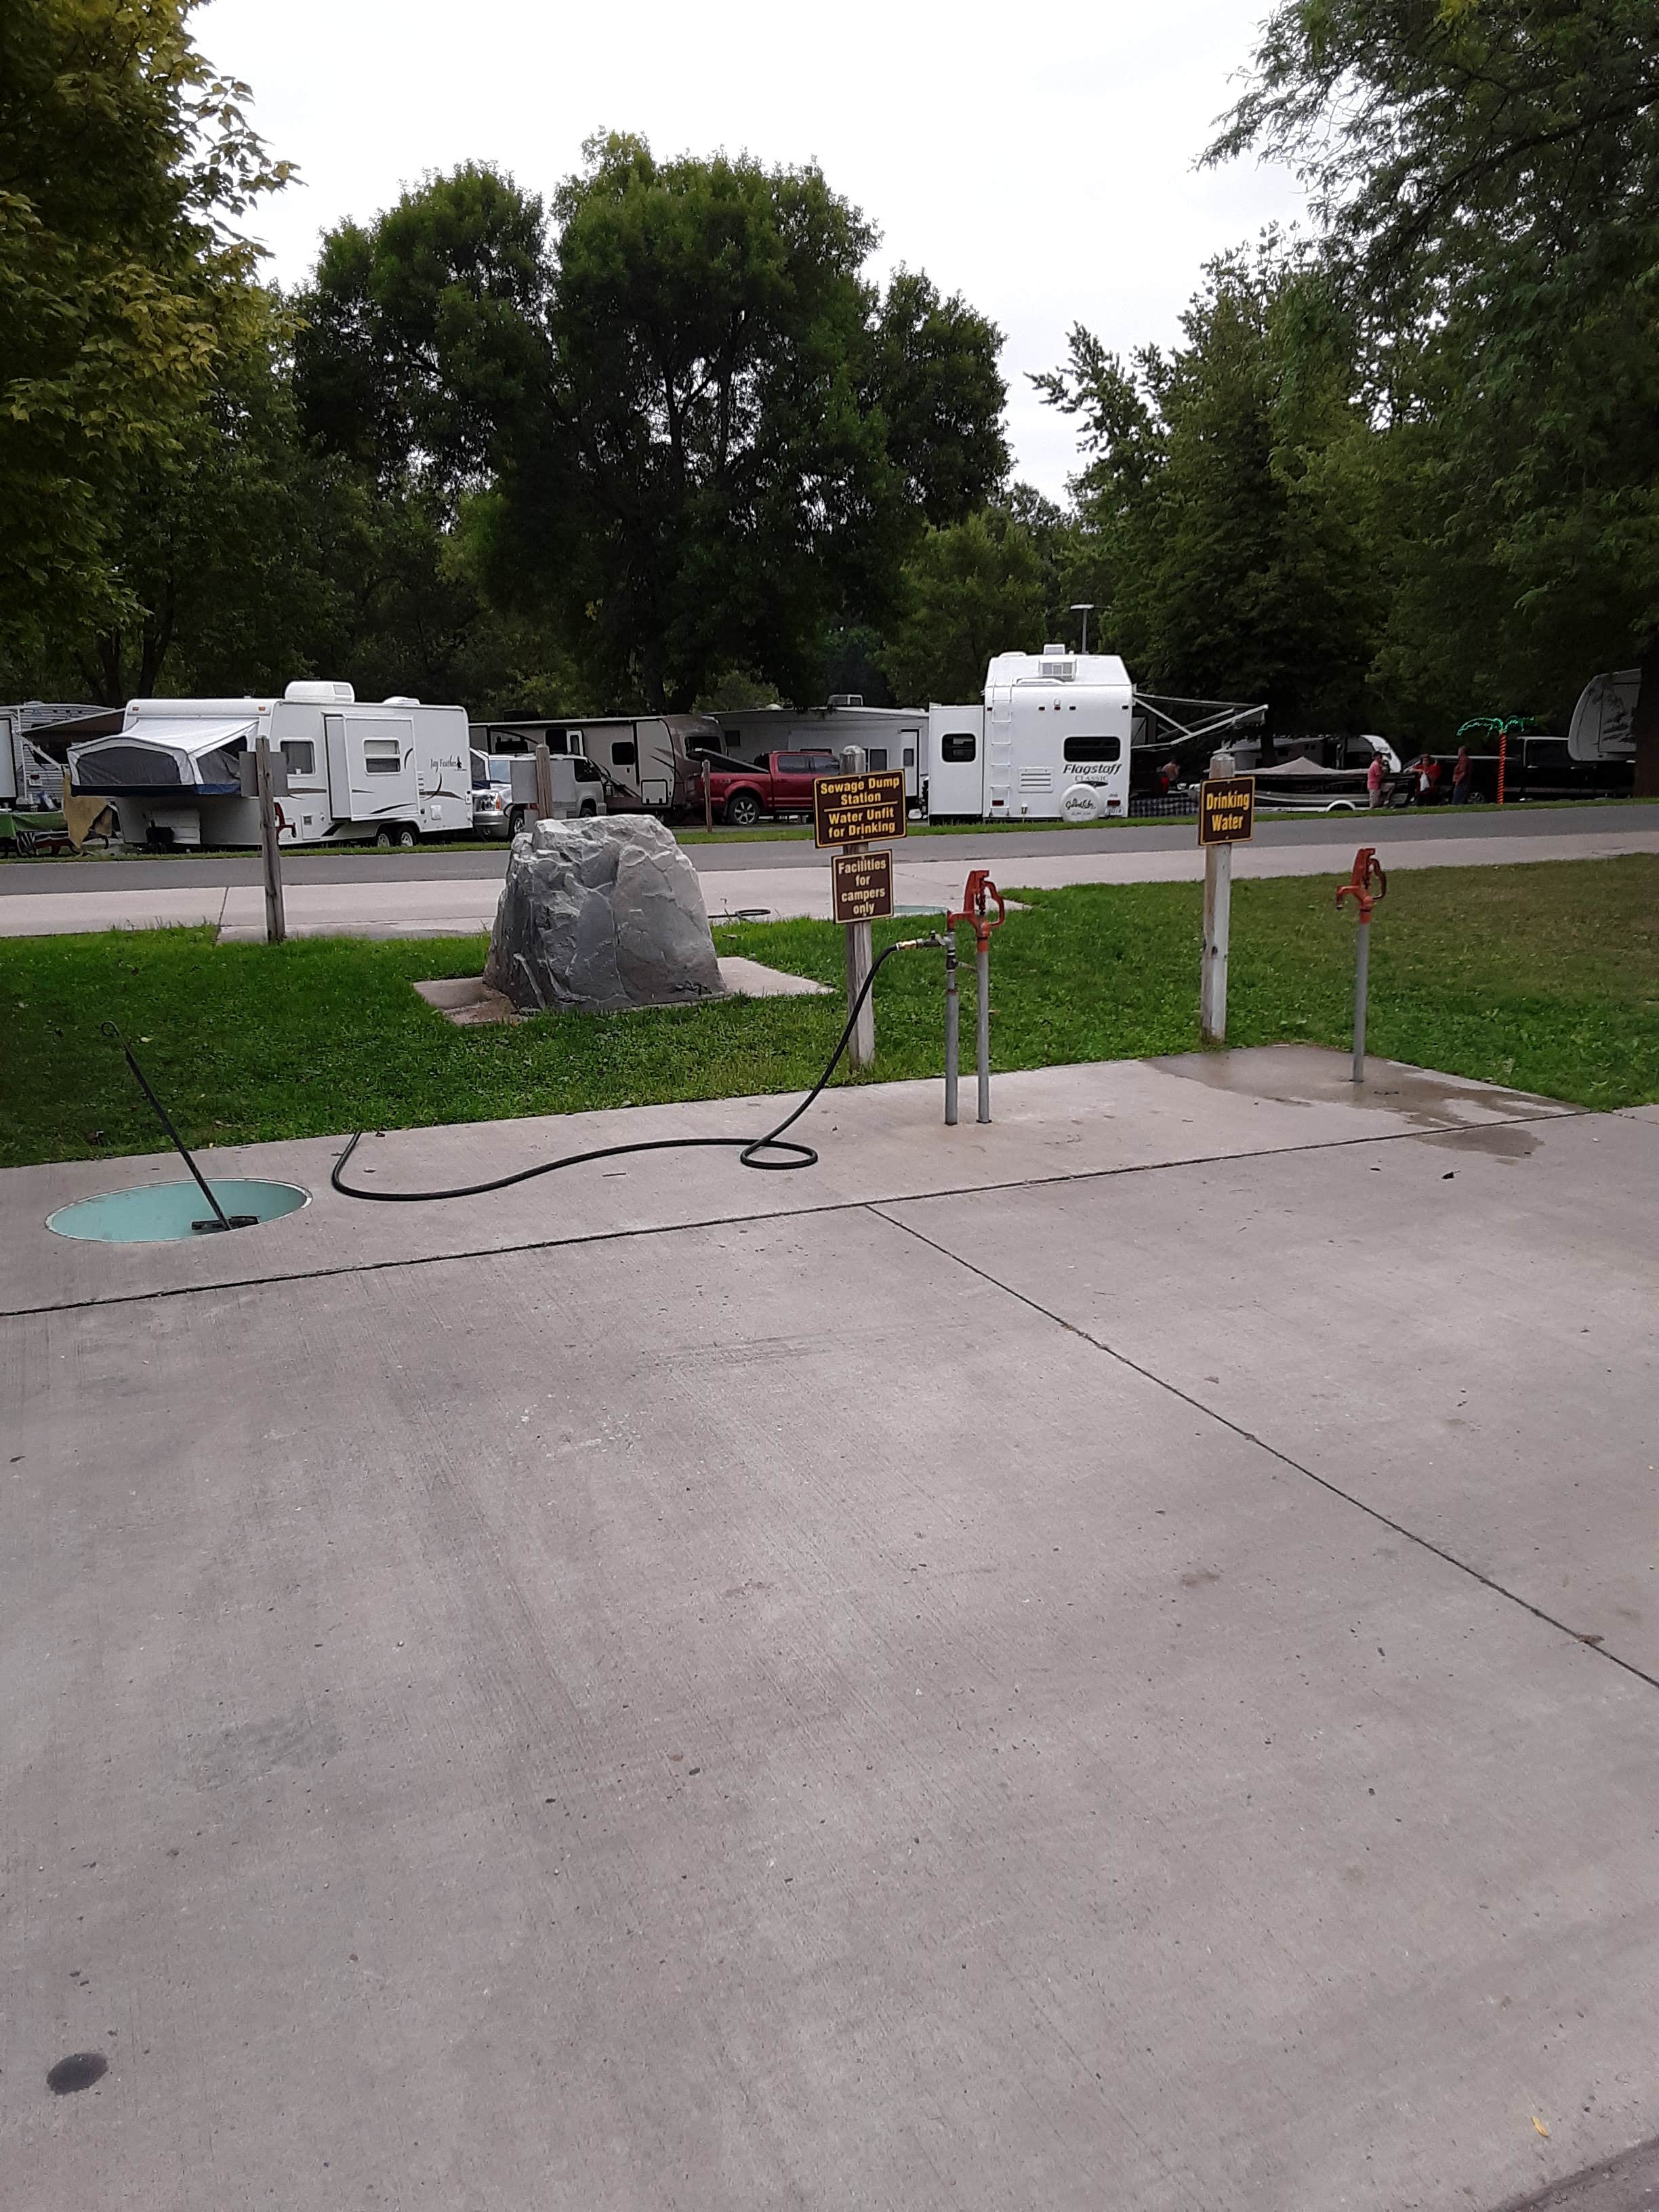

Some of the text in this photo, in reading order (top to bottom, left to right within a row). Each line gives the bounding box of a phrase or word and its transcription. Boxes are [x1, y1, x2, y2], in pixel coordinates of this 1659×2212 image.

[1063, 764, 1122, 775] Flagstaff
[820, 777, 900, 794] Sewage Dump
[840, 792, 881, 806] Station
[1206, 790, 1250, 811] Drinking
[828, 807, 894, 825] Water Unfit
[1212, 813, 1244, 832] Water
[828, 821, 895, 838] for Drinking
[838, 859, 886, 874] Facilities
[855, 875, 871, 887] for
[841, 888, 886, 902] campers
[853, 901, 875, 915] only
